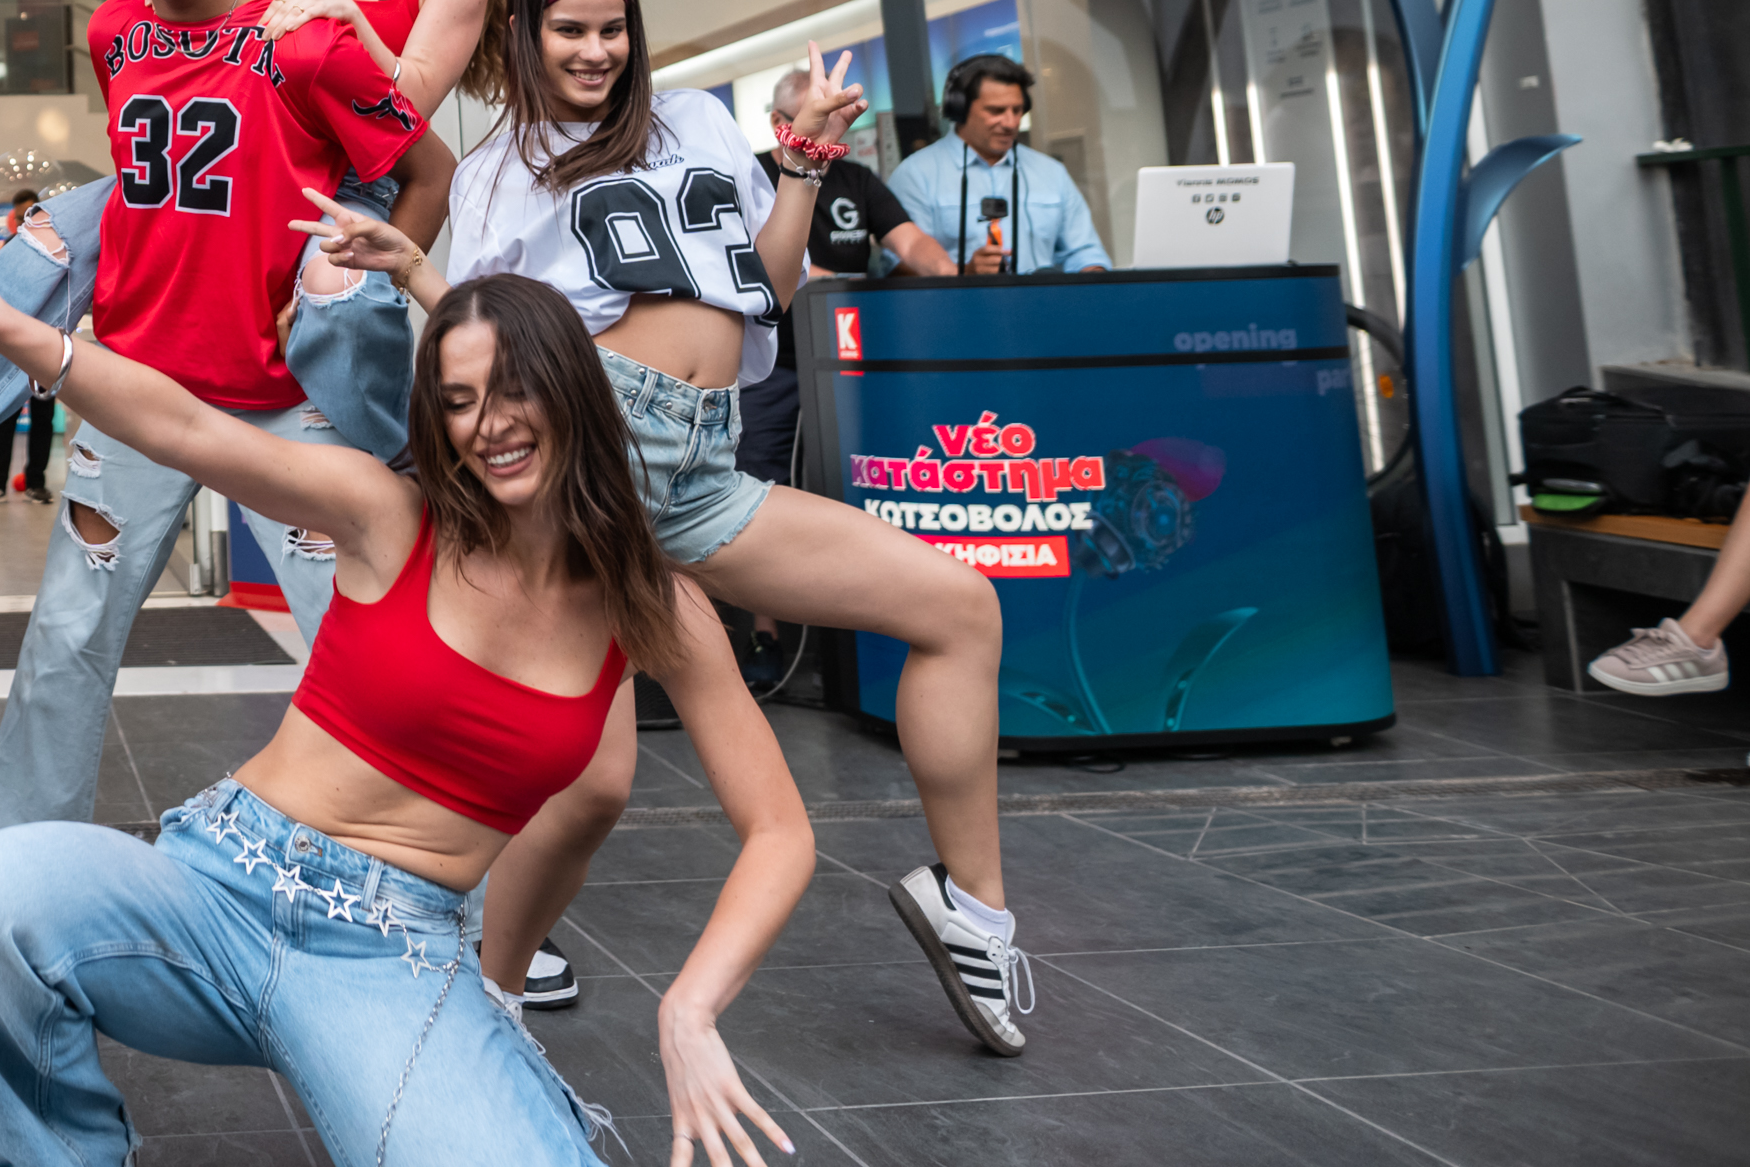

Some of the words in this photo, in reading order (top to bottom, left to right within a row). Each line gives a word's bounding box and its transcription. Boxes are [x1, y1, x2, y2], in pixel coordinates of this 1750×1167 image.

[118, 93, 242, 218] 32
[1206, 206, 1225, 225] hp
[1173, 322, 1298, 368] opening
[932, 410, 1037, 458] νέο
[850, 444, 1107, 503] κατάστημα
